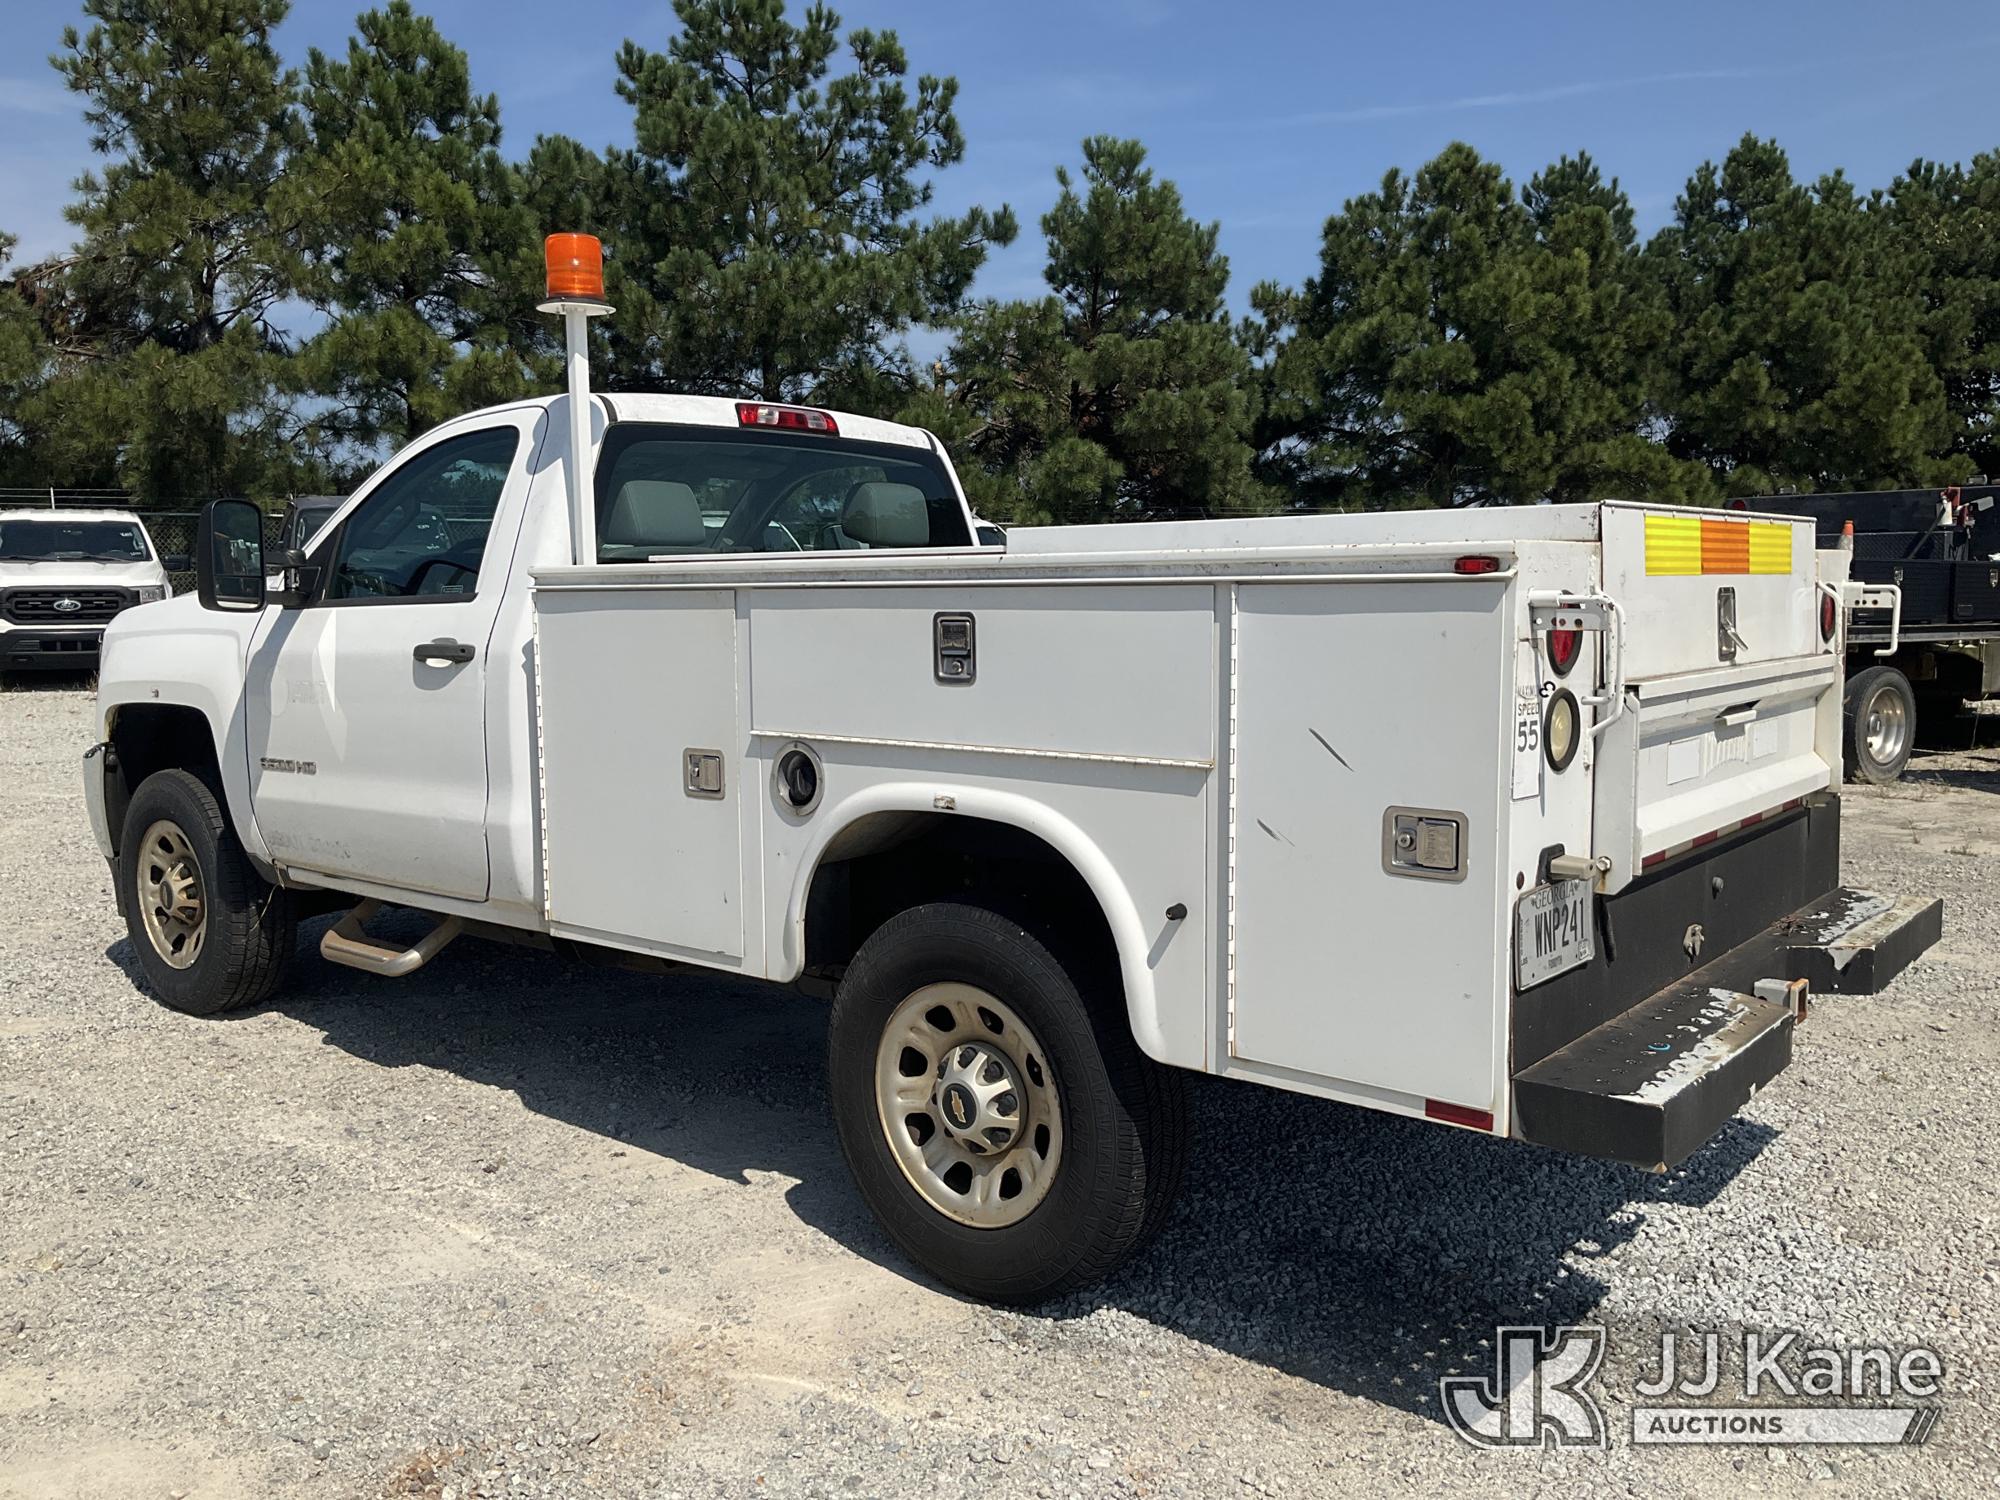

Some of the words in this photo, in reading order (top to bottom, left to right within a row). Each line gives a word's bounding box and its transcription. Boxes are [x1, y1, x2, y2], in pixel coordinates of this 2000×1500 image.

[1518, 702, 1539, 716] SPEED
[1517, 720, 1538, 752] 55
[1534, 883, 1575, 909] GEORGIA
[1534, 897, 1584, 958] WNP241
